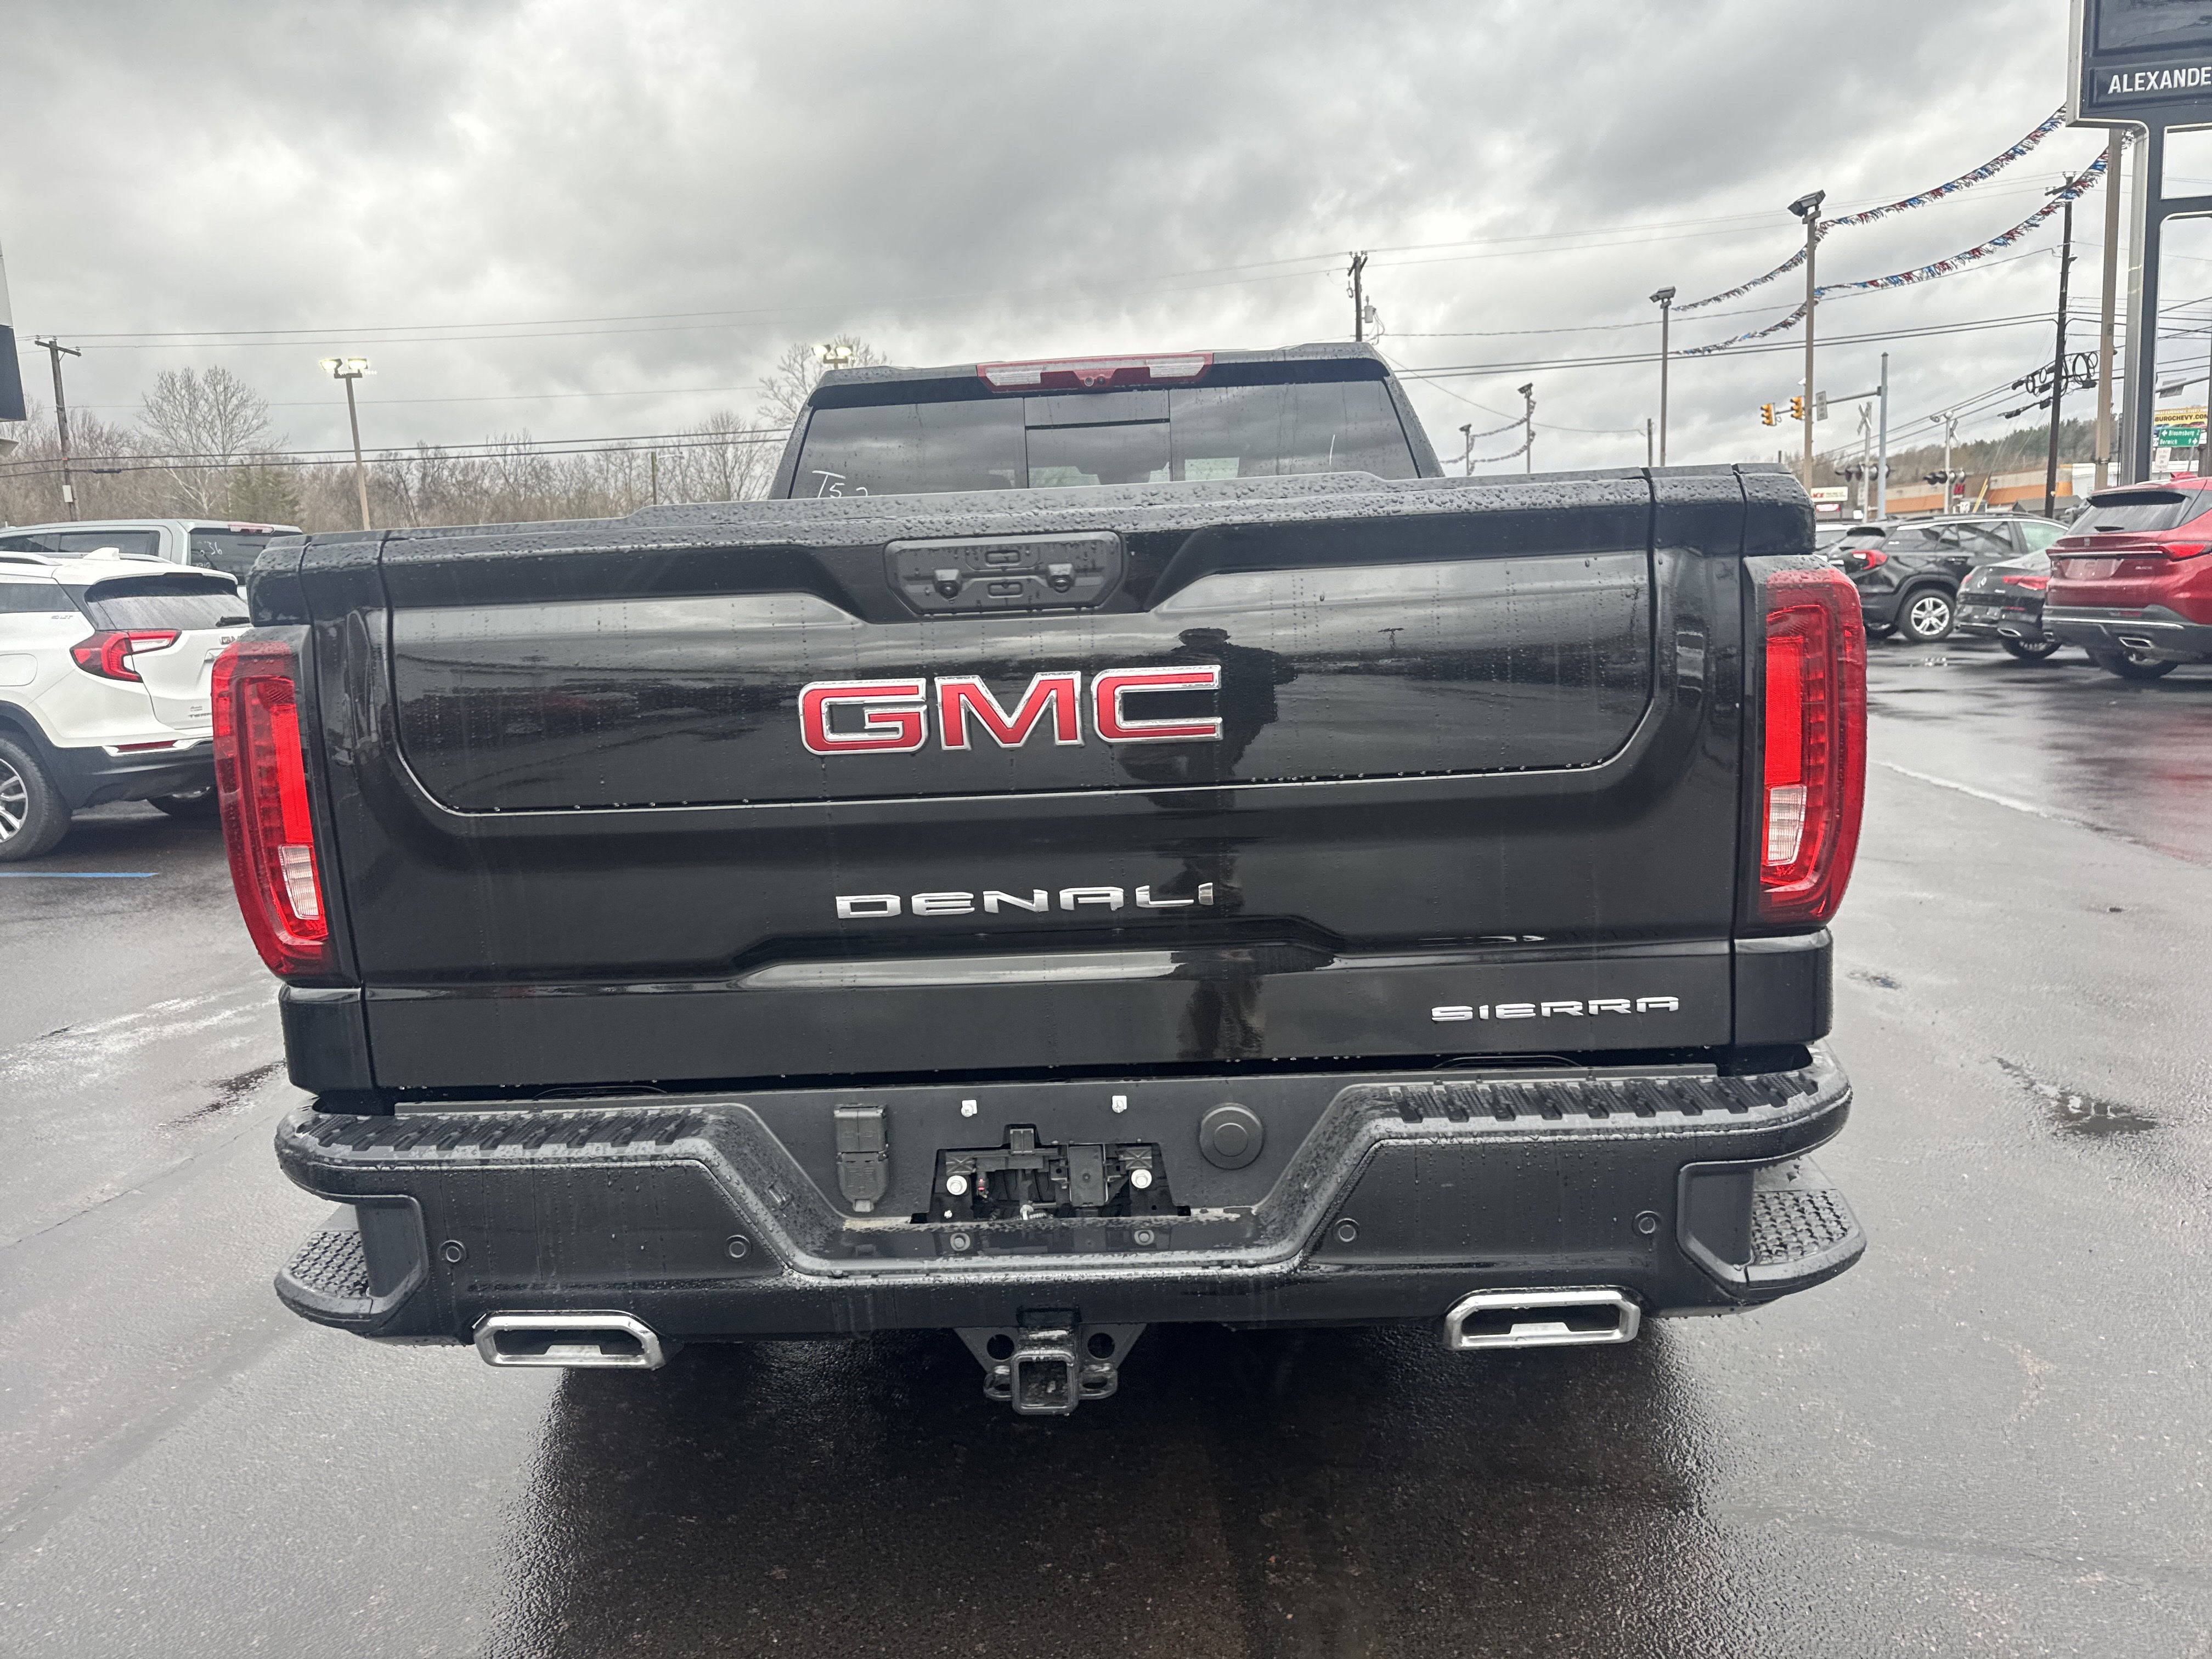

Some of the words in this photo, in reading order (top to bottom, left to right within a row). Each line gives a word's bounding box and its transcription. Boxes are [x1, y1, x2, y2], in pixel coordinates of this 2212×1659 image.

[2108, 66, 2212, 94] ALEXANDE
[798, 664, 1224, 755] GMC
[836, 882, 1214, 919] DENALI
[1431, 996, 1679, 1022] SIERRA
